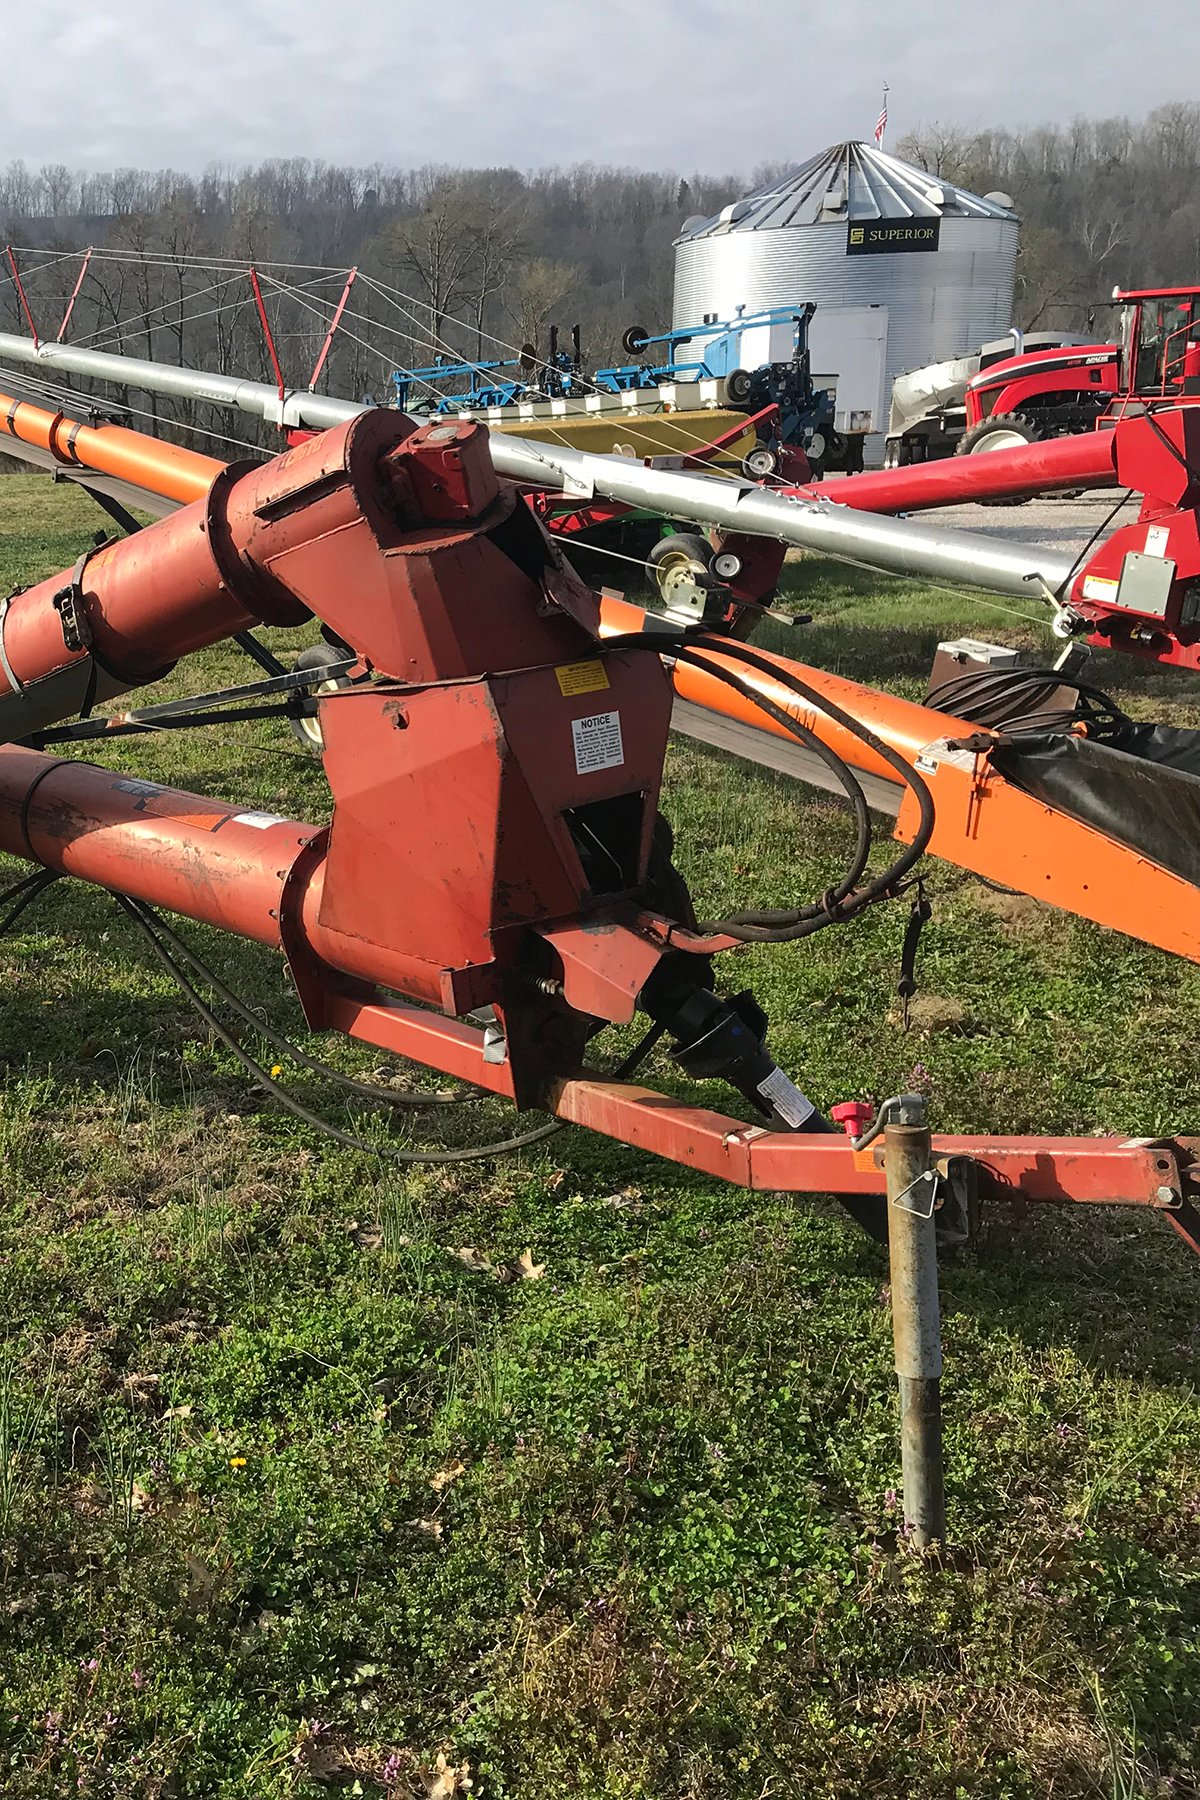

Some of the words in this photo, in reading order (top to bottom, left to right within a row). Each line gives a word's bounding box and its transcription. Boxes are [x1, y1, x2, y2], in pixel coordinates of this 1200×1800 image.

[869, 228, 934, 241] SUPERIOR
[1085, 355, 1109, 364] APACHE
[581, 714, 611, 729] NOTICE
